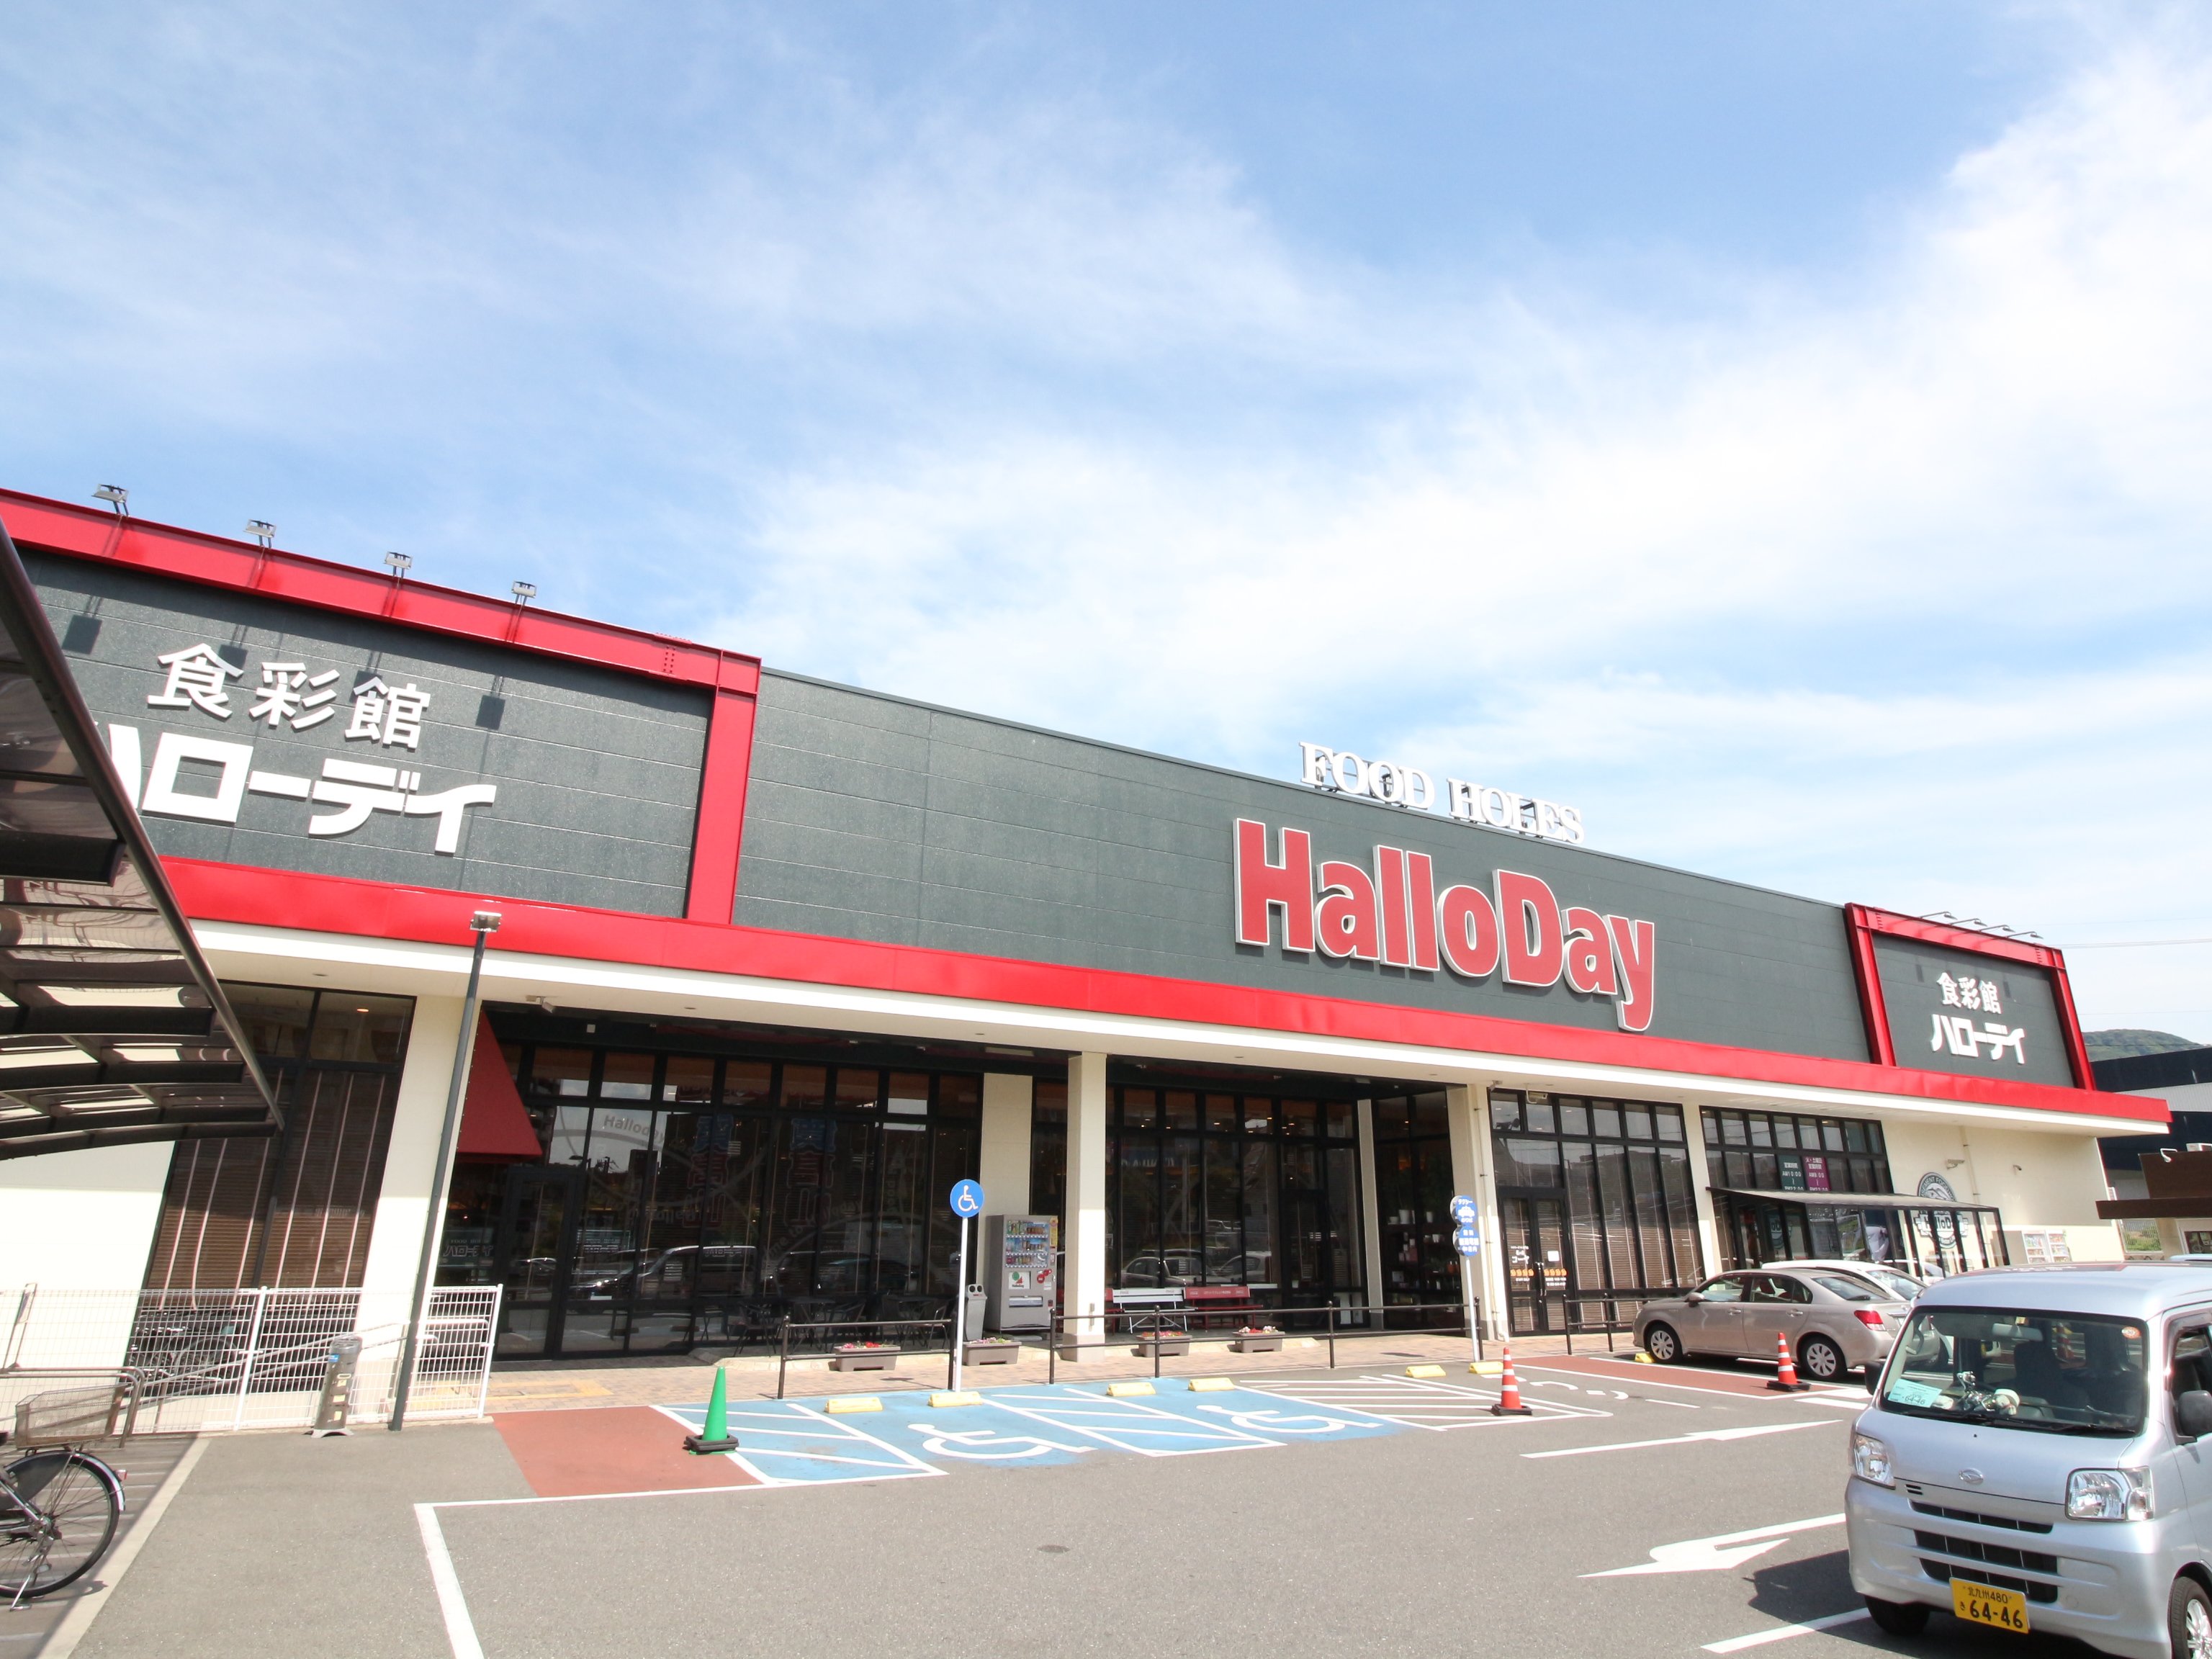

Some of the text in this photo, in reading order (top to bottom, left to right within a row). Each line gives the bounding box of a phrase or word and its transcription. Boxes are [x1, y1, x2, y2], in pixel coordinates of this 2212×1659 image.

[147, 642, 431, 751] 食彩館
[1299, 742, 1585, 845] FOOD HOLES
[1233, 817, 1655, 1033] HalloDay
[1936, 971, 2002, 1015] 食彩館
[1930, 1013, 2025, 1065] ハローディ
[1969, 1599, 2023, 1629] 64-46
